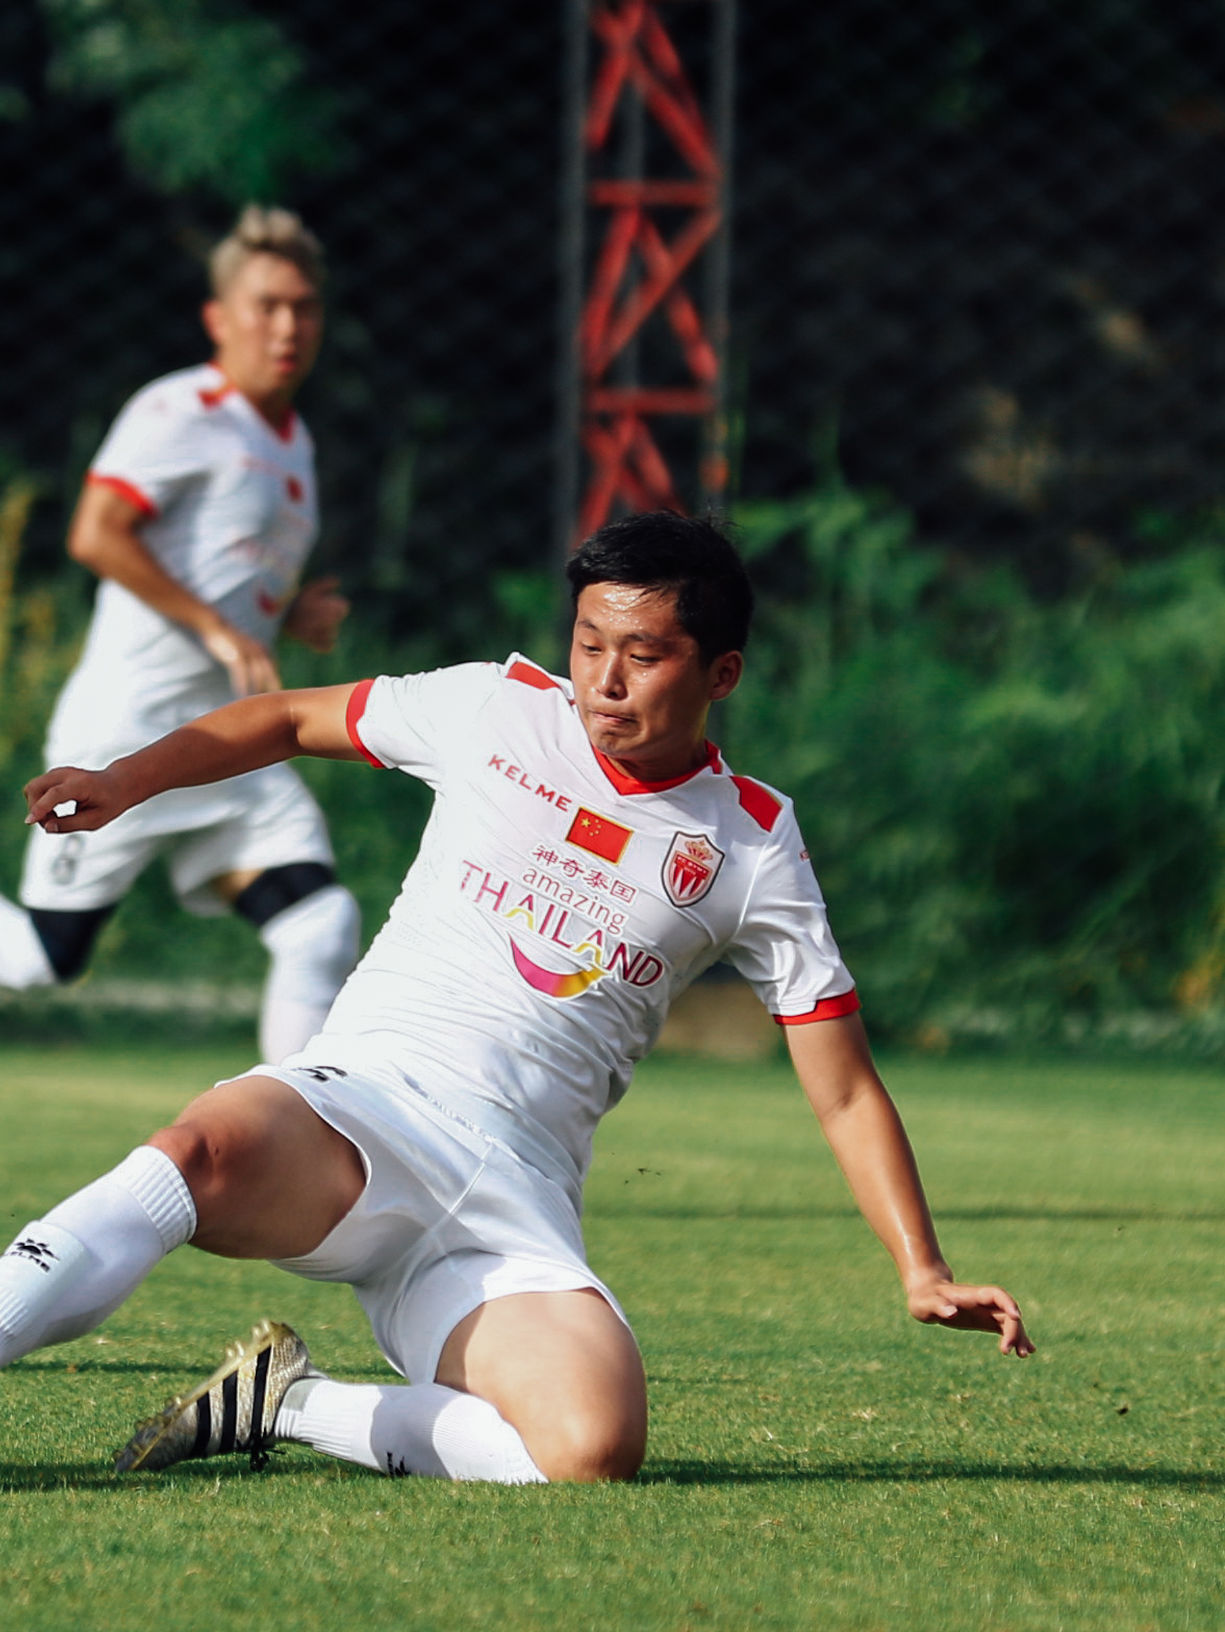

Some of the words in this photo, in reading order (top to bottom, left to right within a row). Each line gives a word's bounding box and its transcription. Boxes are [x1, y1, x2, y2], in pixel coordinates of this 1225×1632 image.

[488, 753, 573, 812] KELME
[523, 867, 626, 936] amazing
[533, 844, 637, 903] 神奇泰国
[461, 859, 664, 988] THAILAND
